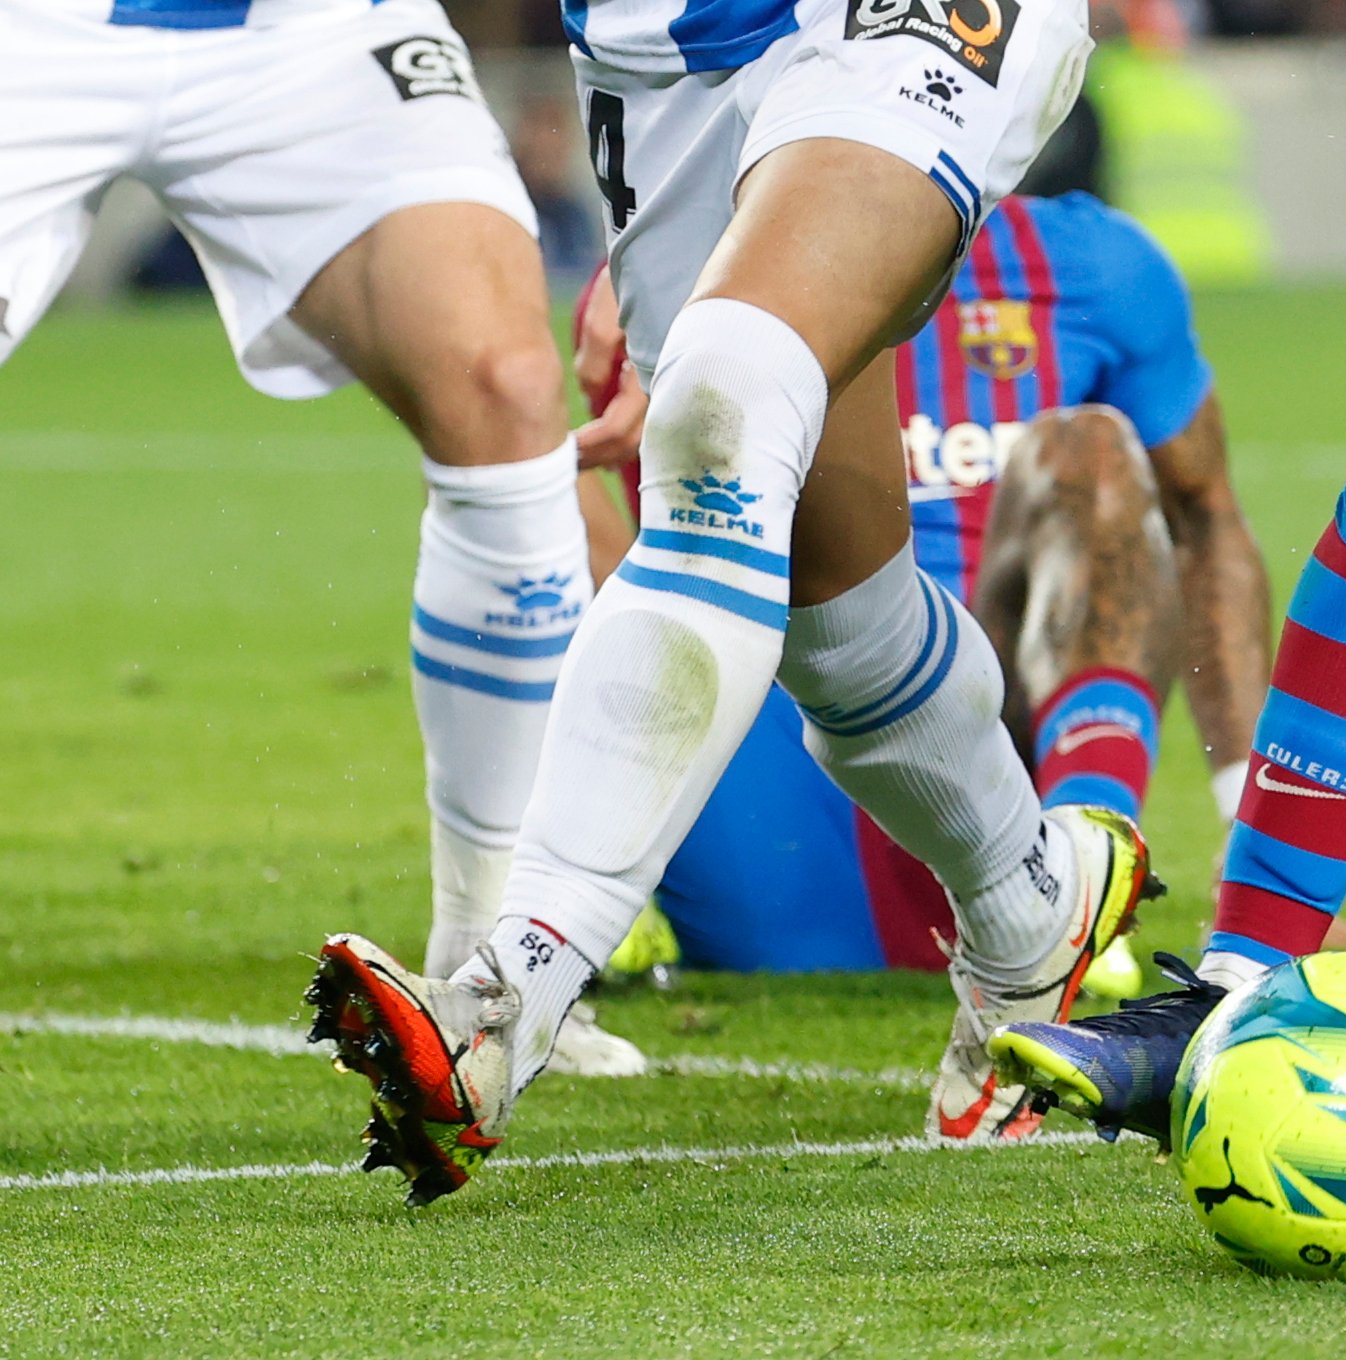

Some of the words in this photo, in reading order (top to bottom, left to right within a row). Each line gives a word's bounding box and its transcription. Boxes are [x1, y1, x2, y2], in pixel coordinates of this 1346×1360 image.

[854, 17, 904, 41] Global
[905, 16, 963, 52] Racing
[899, 86, 966, 129] KELME
[669, 508, 764, 540] KELME
